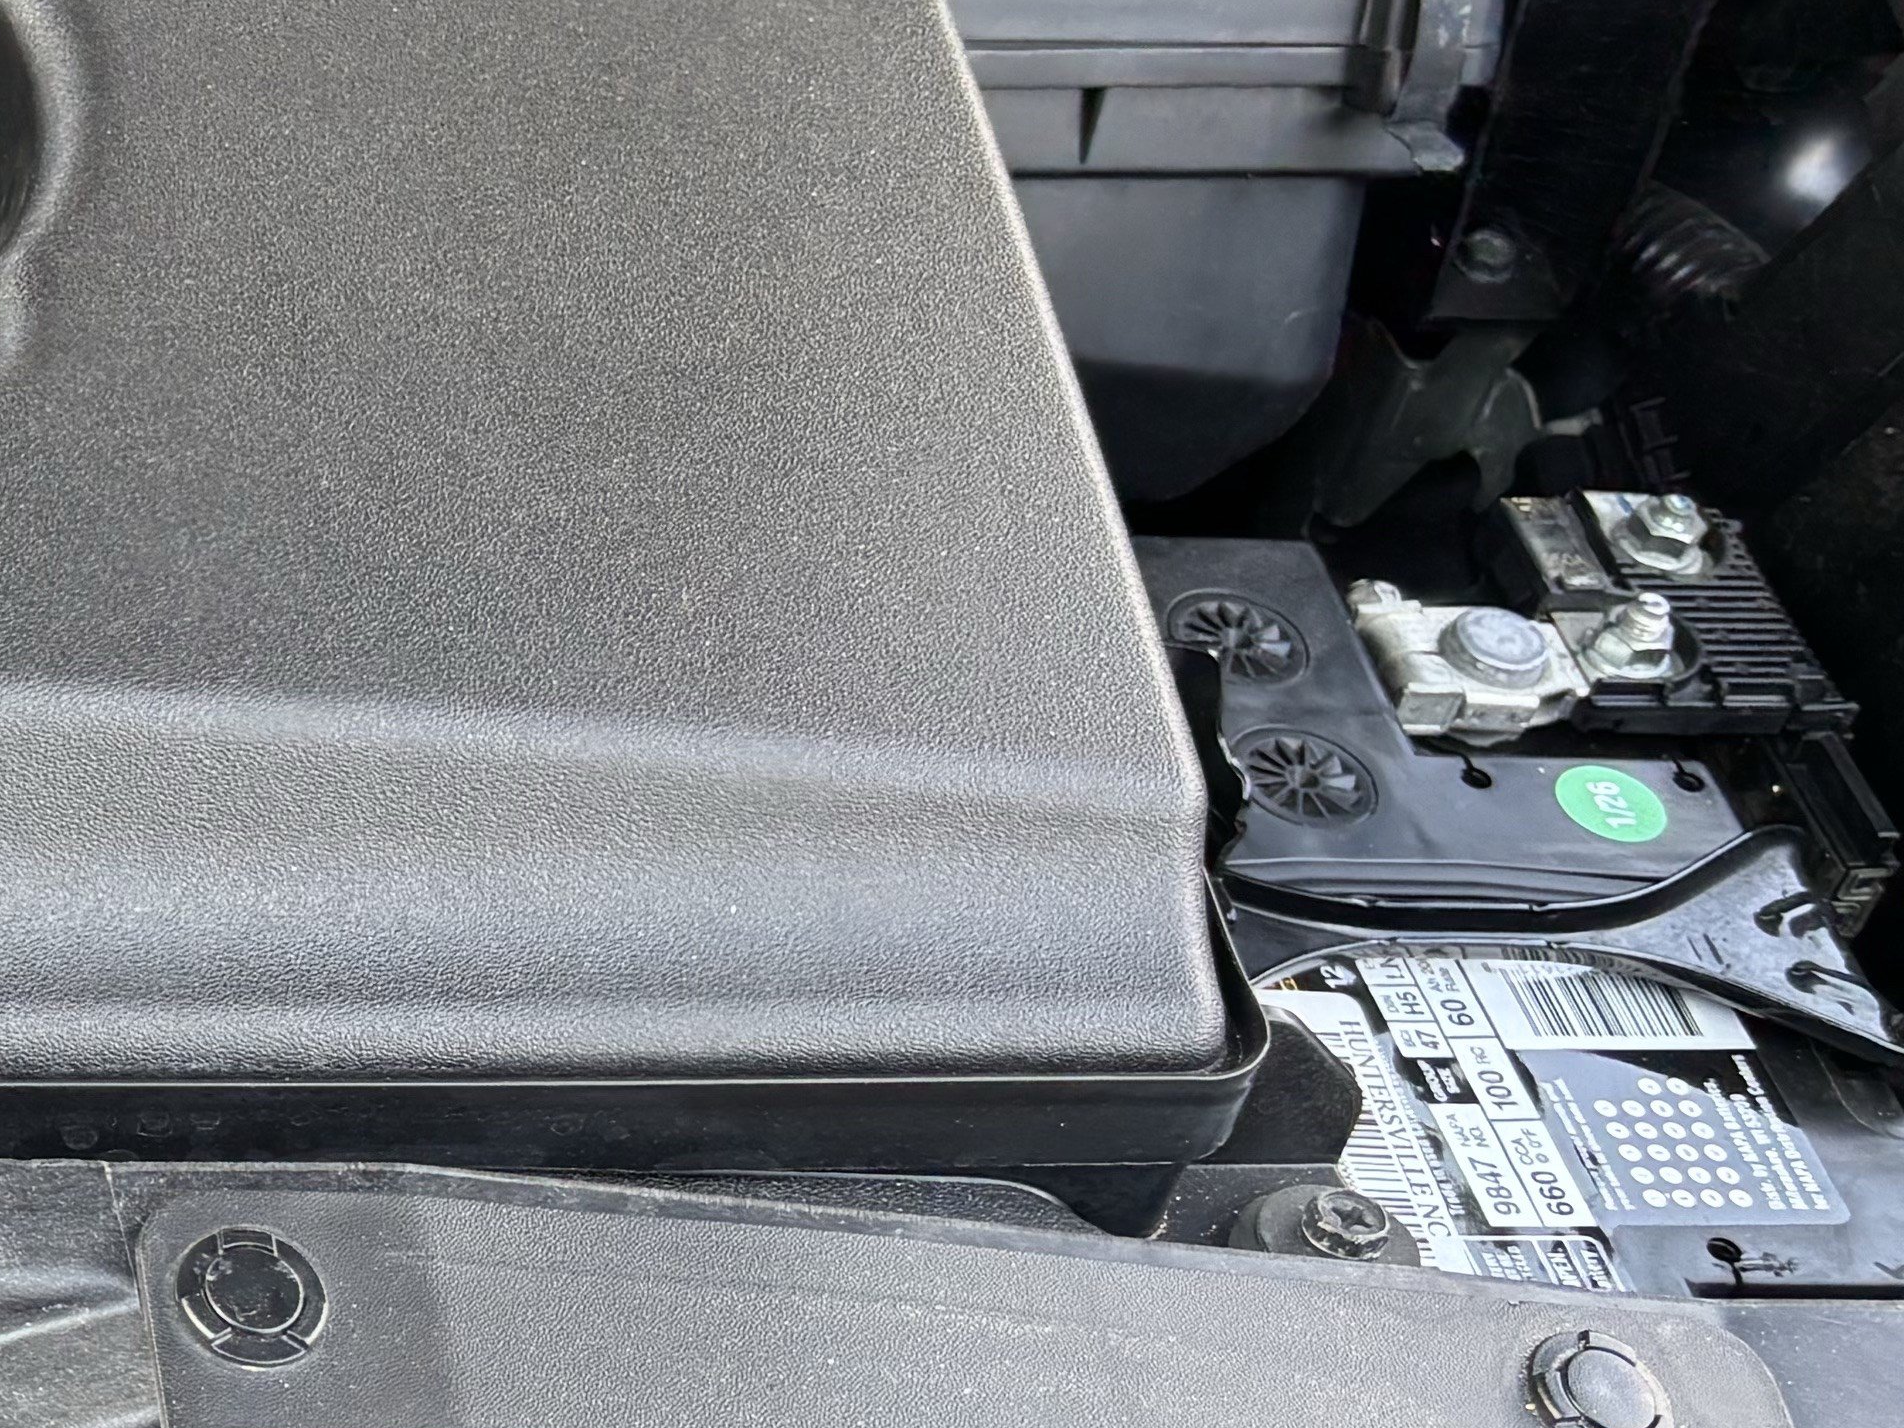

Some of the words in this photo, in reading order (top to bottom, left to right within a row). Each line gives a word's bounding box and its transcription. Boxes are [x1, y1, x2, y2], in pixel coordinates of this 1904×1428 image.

[1585, 781, 1637, 828] 1/26
[1397, 991, 1425, 1016] H5
[1440, 999, 1475, 1026] 60
[1414, 1029, 1440, 1050] 47
[1477, 1070, 1519, 1112] 100
[1339, 1020, 1434, 1197] HUNTERSVILLE
[1416, 1203, 1452, 1238] NC
[1446, 1113, 1472, 1148] NAPA
[1468, 1156, 1521, 1216] 9847
[1531, 1171, 1574, 1217] 660
